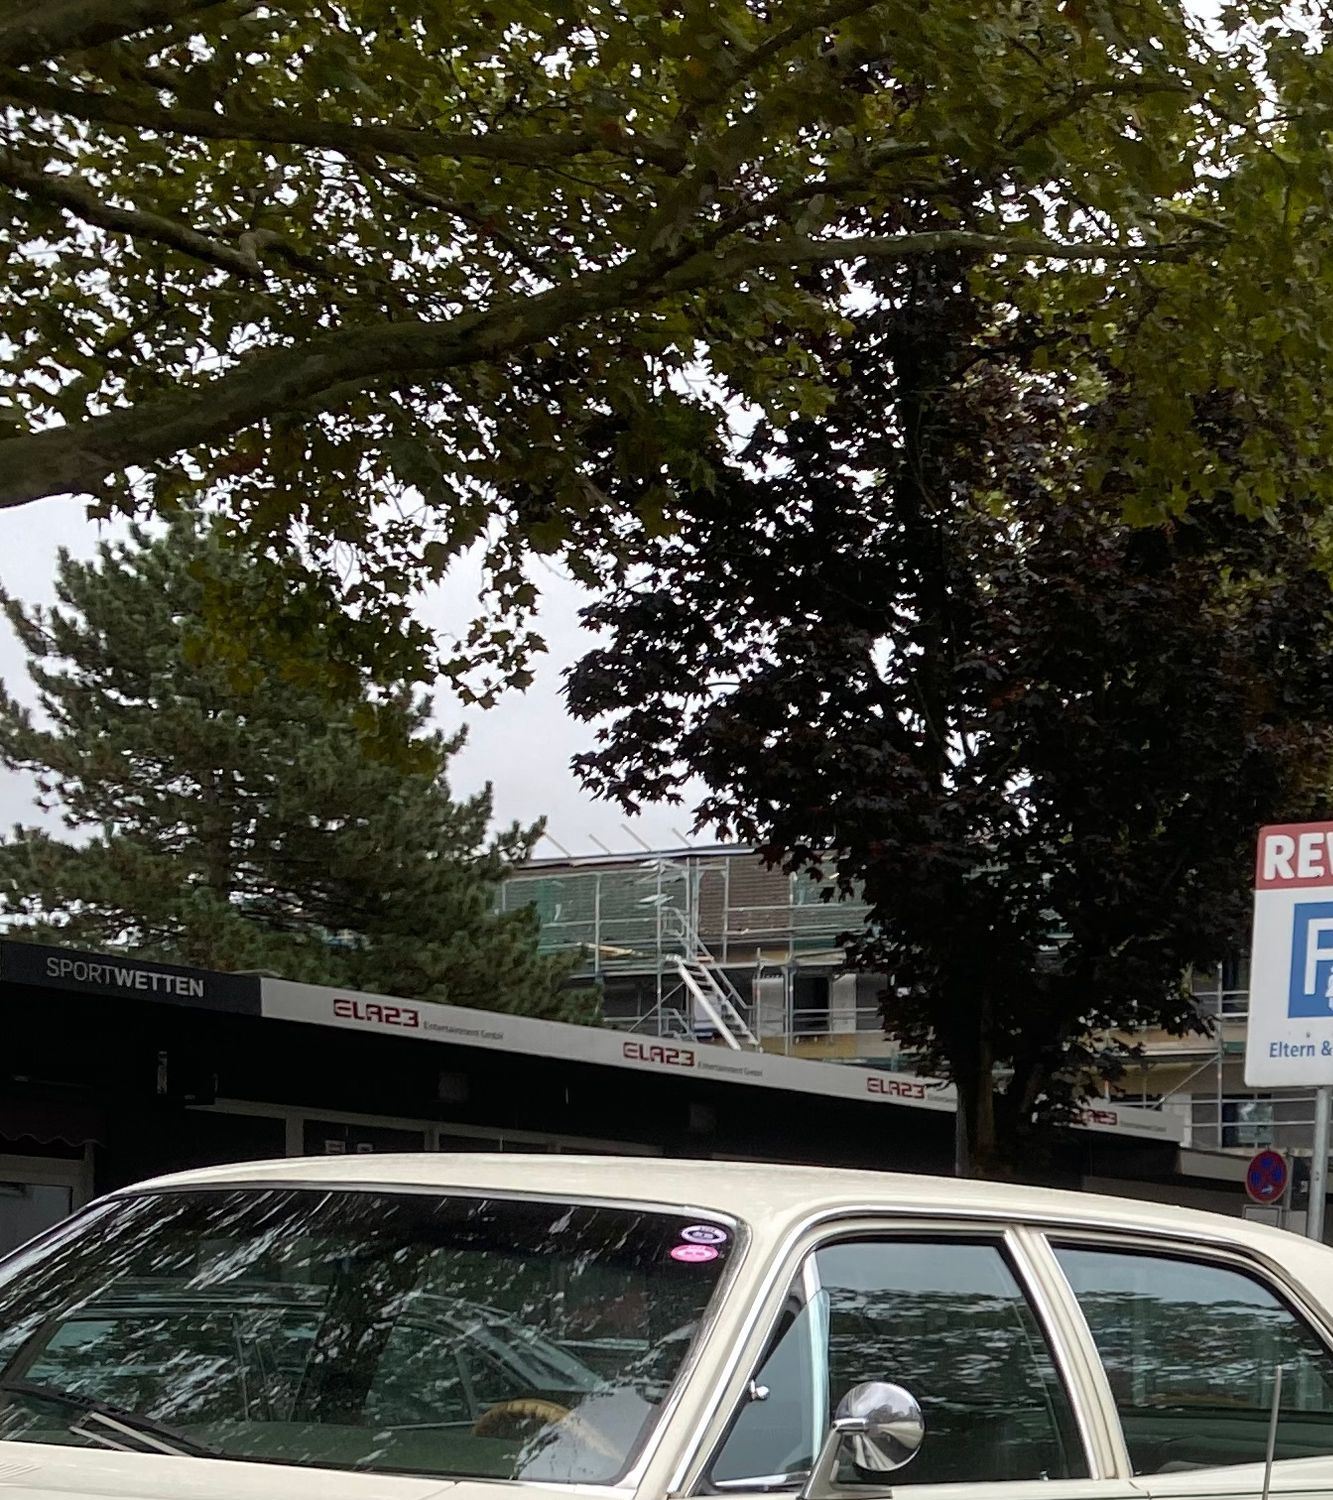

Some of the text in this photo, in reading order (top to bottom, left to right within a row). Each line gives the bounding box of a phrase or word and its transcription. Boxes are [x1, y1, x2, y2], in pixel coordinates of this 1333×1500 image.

[46, 957, 204, 997] SPORTWETTEN
[1269, 1042, 1315, 1058] Eltern
[1321, 1041, 1332, 1056] &
